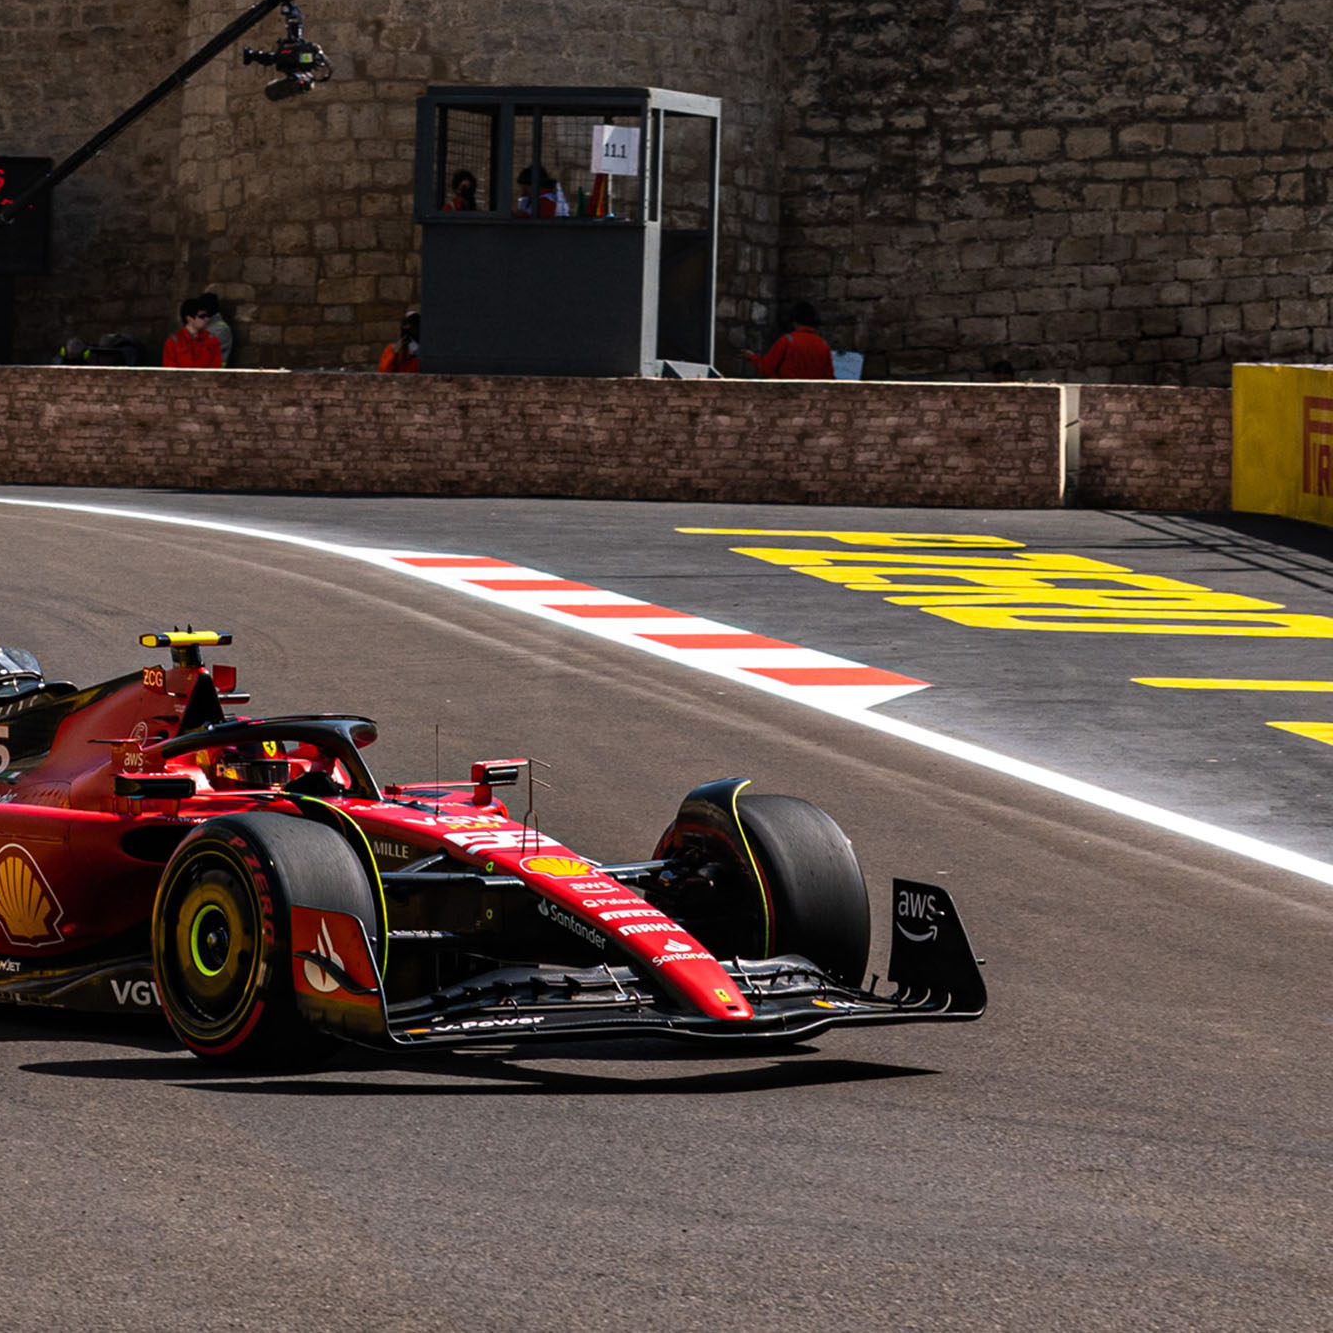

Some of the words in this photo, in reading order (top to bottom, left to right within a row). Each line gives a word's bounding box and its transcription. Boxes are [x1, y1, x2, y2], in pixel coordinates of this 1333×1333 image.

[604, 143, 627, 159] 11.1
[143, 669, 164, 686] ZCG
[124, 752, 144, 767] aws
[403, 814, 508, 827] VGW
[373, 841, 409, 859] MILLE
[443, 830, 563, 856] 55
[569, 881, 613, 890] aws
[898, 890, 937, 921] aws
[550, 904, 607, 951] Santander
